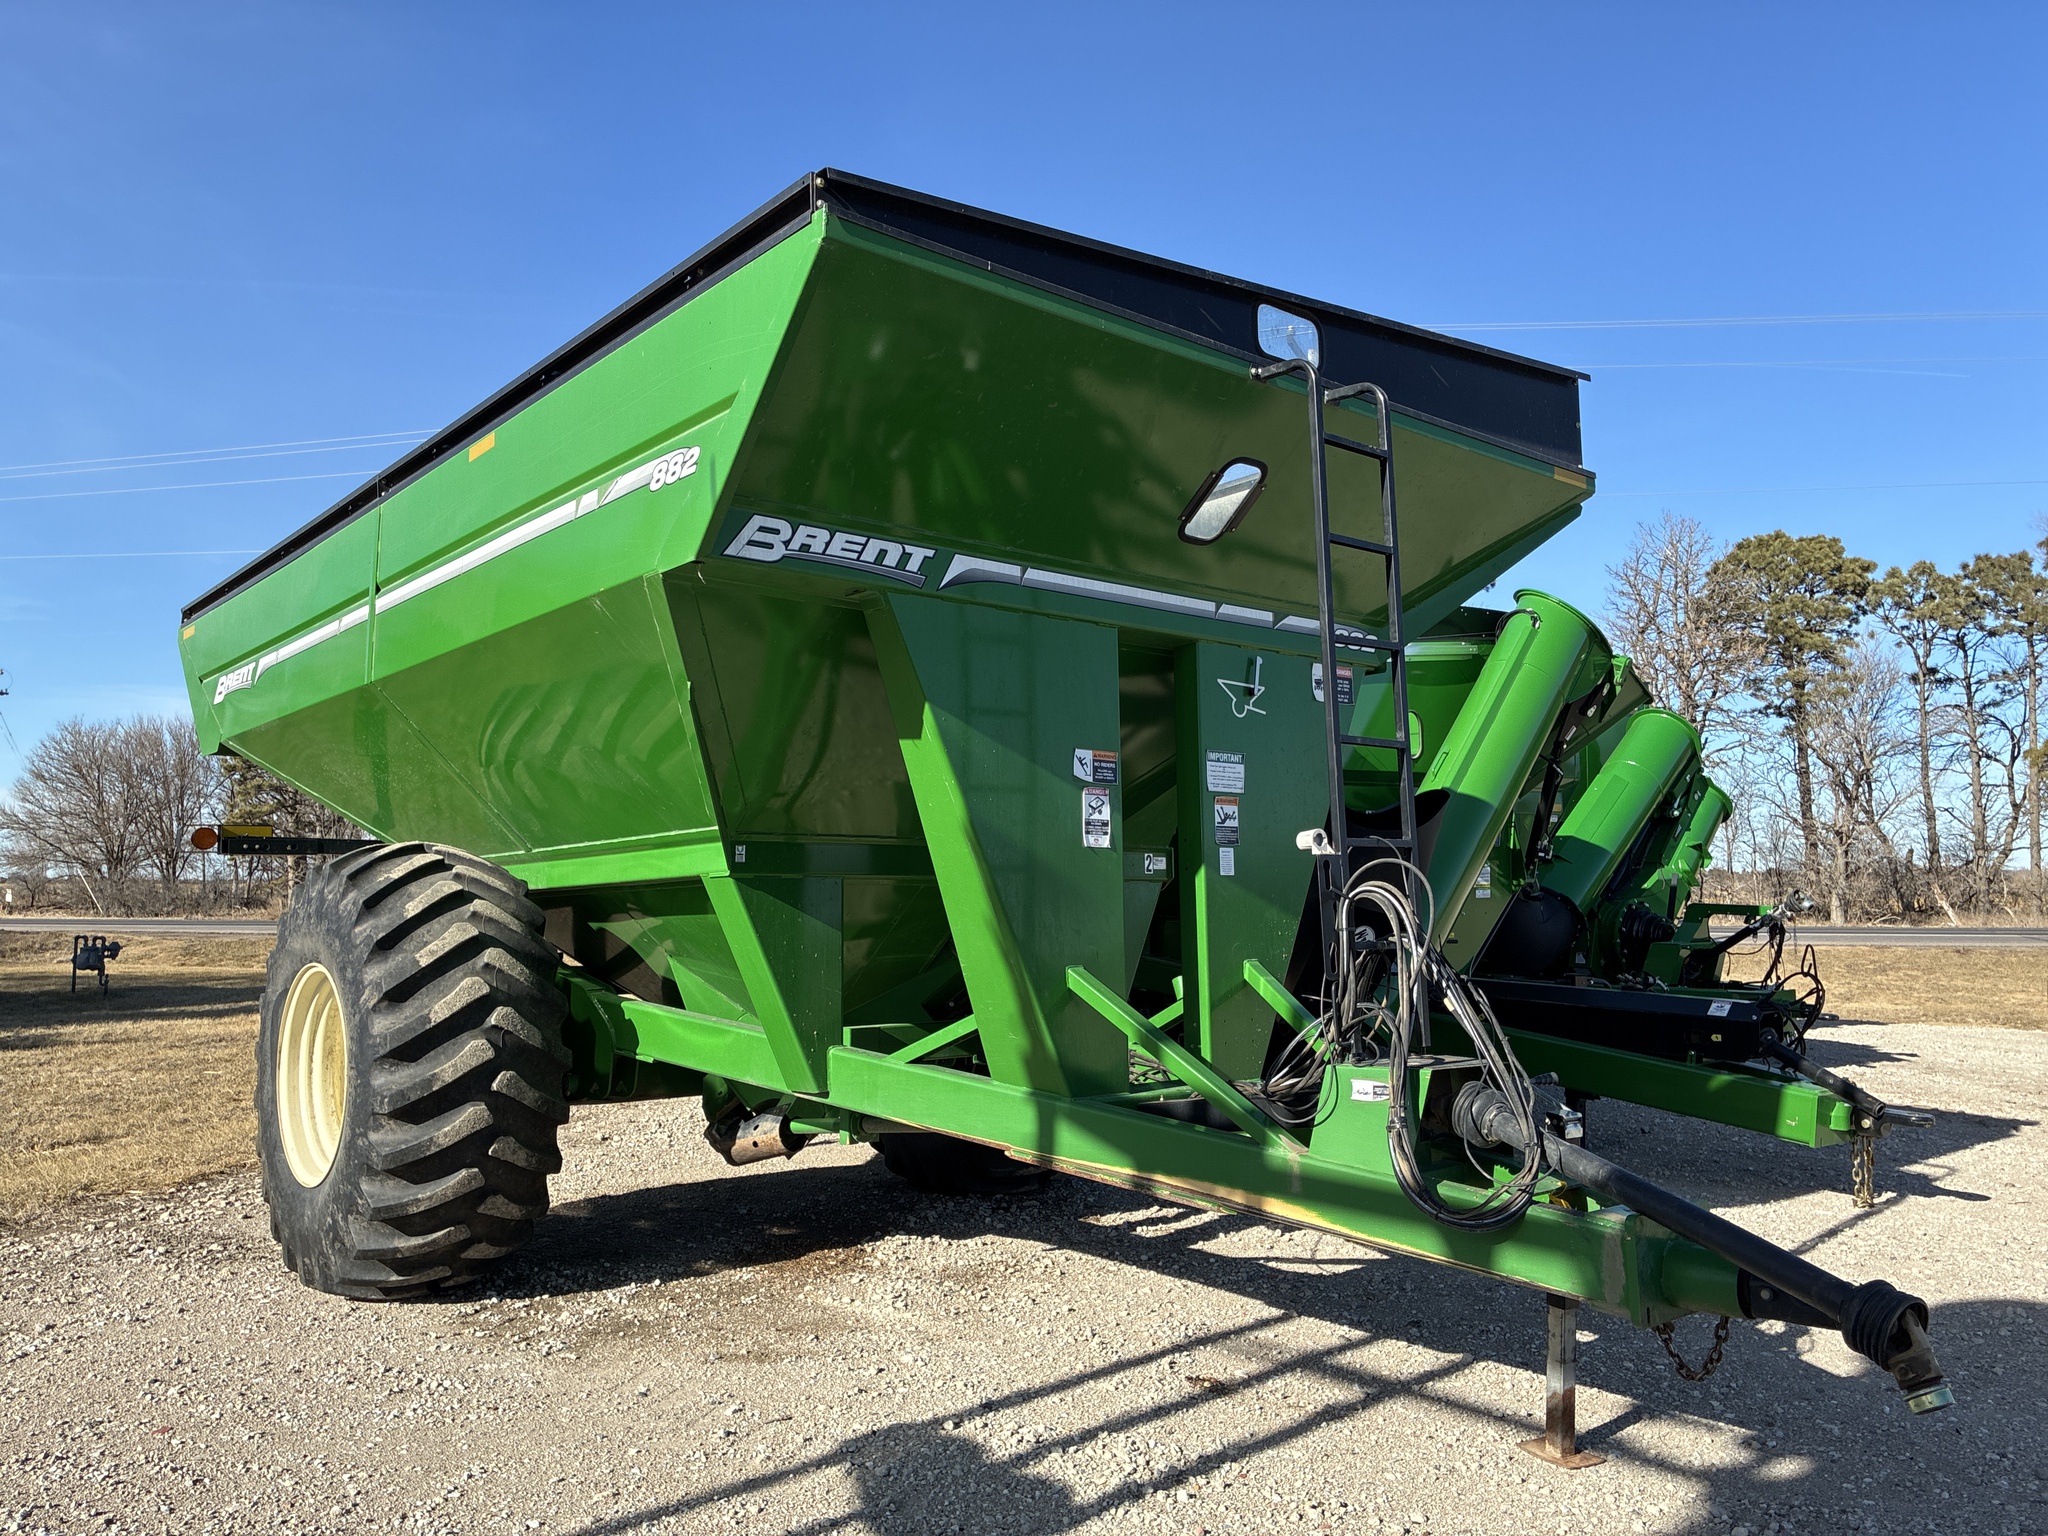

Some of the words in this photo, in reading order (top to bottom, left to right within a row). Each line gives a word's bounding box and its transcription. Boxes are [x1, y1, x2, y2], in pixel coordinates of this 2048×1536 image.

[649, 445, 701, 492] 882
[722, 513, 937, 575] BRENT
[213, 661, 256, 705] BRENT
[1208, 752, 1243, 763] IMPORTANT
[1145, 854, 1153, 873] 2
